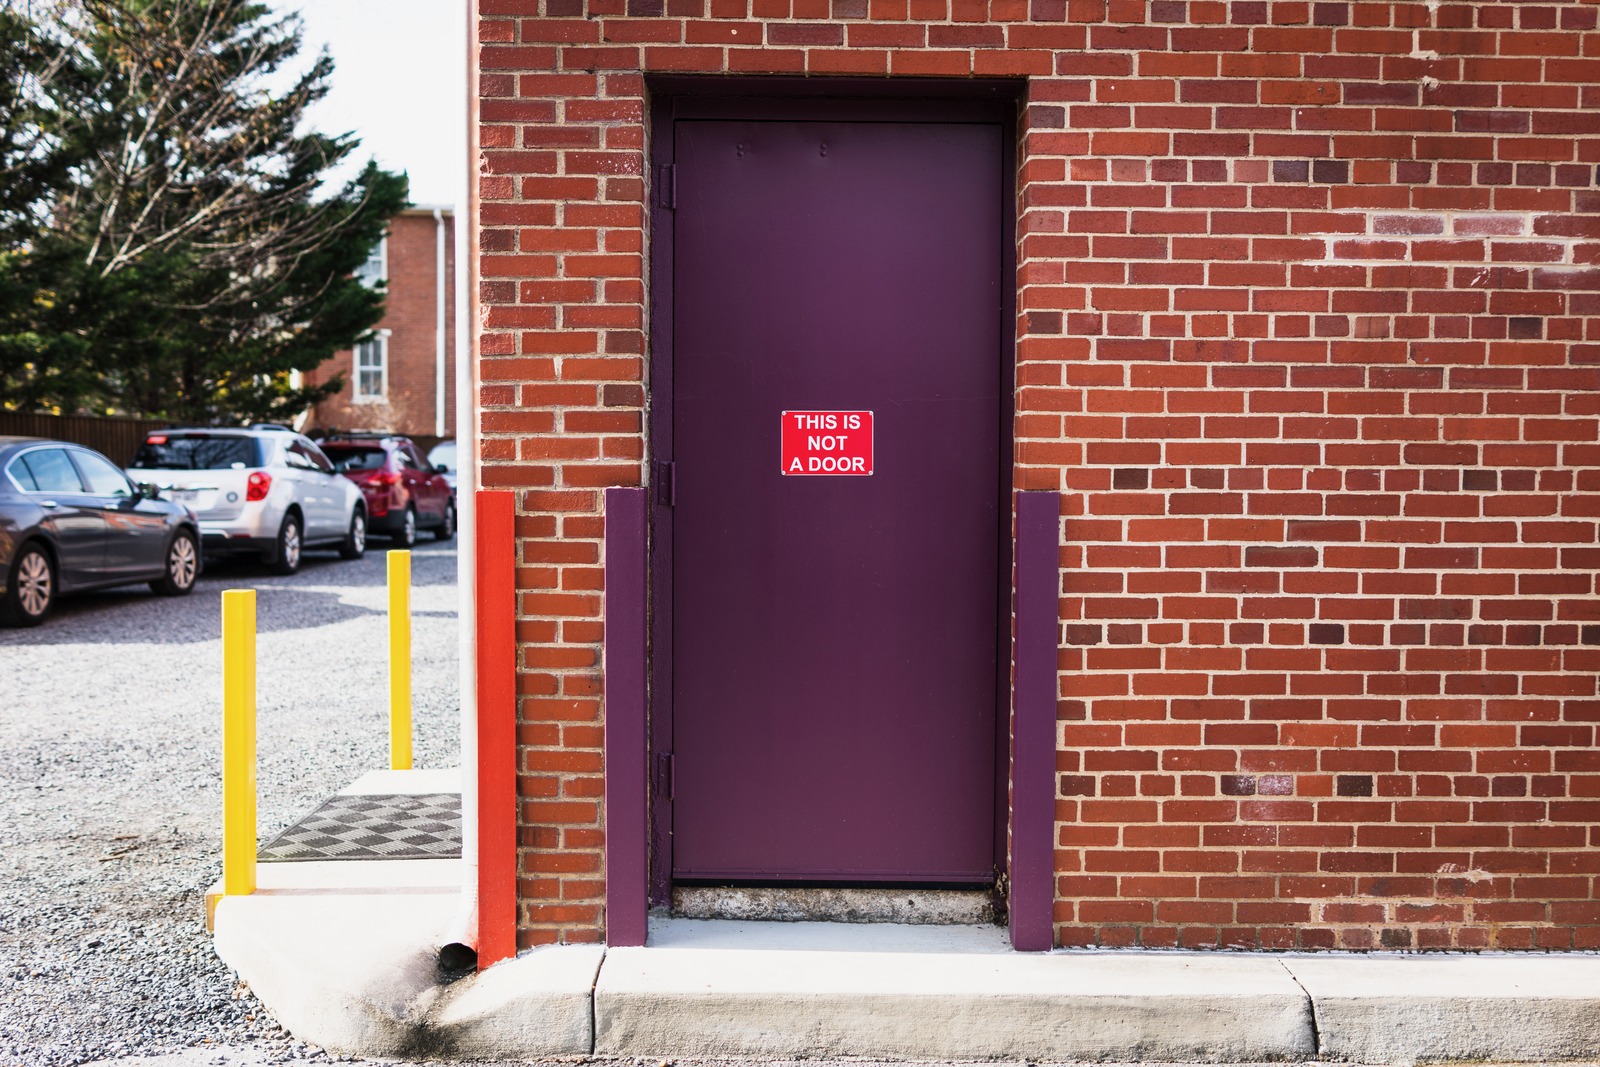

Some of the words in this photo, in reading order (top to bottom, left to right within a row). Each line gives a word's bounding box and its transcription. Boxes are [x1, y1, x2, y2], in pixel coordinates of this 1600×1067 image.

[794, 415, 837, 429] THIS
[843, 415, 861, 429] IS
[808, 436, 848, 450] NOT
[789, 457, 804, 471] A
[808, 457, 865, 471] DOOR
